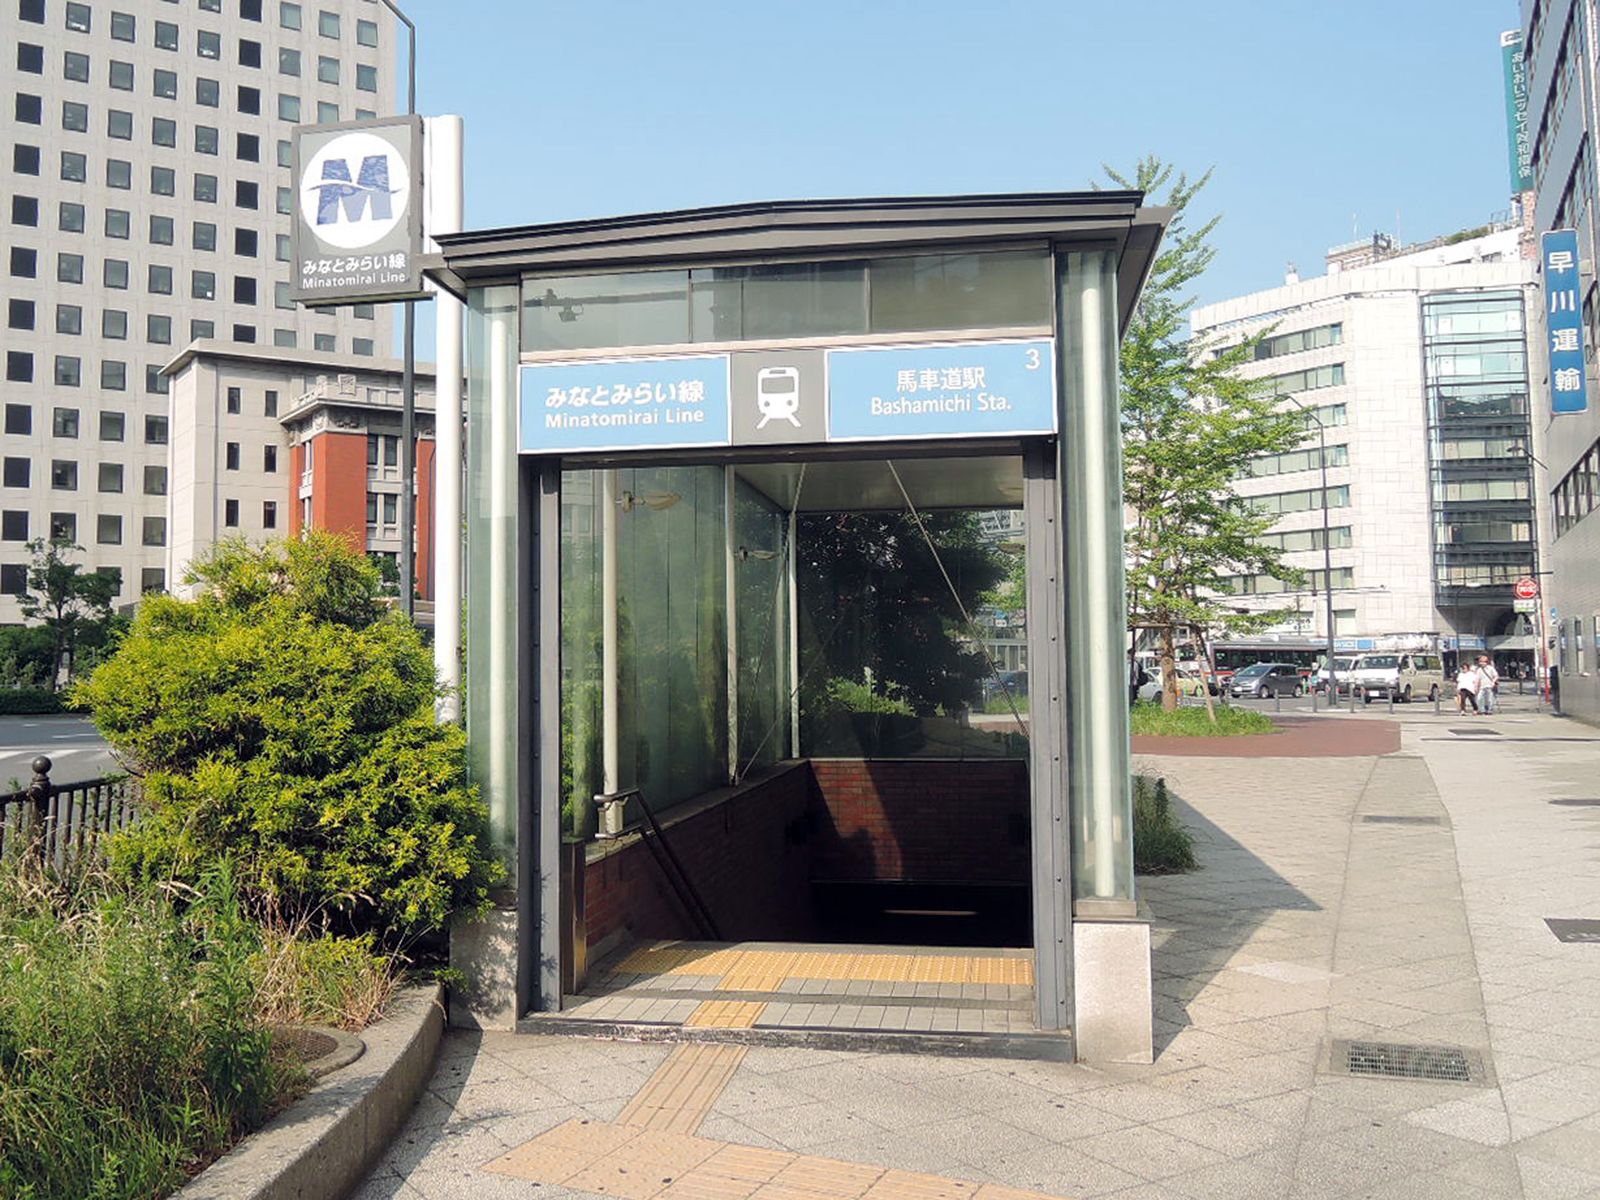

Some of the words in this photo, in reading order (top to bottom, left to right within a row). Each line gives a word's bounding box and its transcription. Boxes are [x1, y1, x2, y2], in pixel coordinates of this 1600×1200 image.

[302, 253, 406, 274] みなとみらい線
[302, 274, 376, 289] Minatomirai
[380, 272, 406, 284] Line
[1548, 251, 1581, 392] 早川運輸
[1025, 348, 1041, 369] 3
[896, 366, 987, 393] 馬車道駅
[544, 379, 705, 408] みなとみらい線
[871, 394, 971, 416] Bashamichi
[976, 391, 1012, 412] Sta.
[544, 408, 659, 429] Minatomirai
[665, 408, 705, 425] Line
